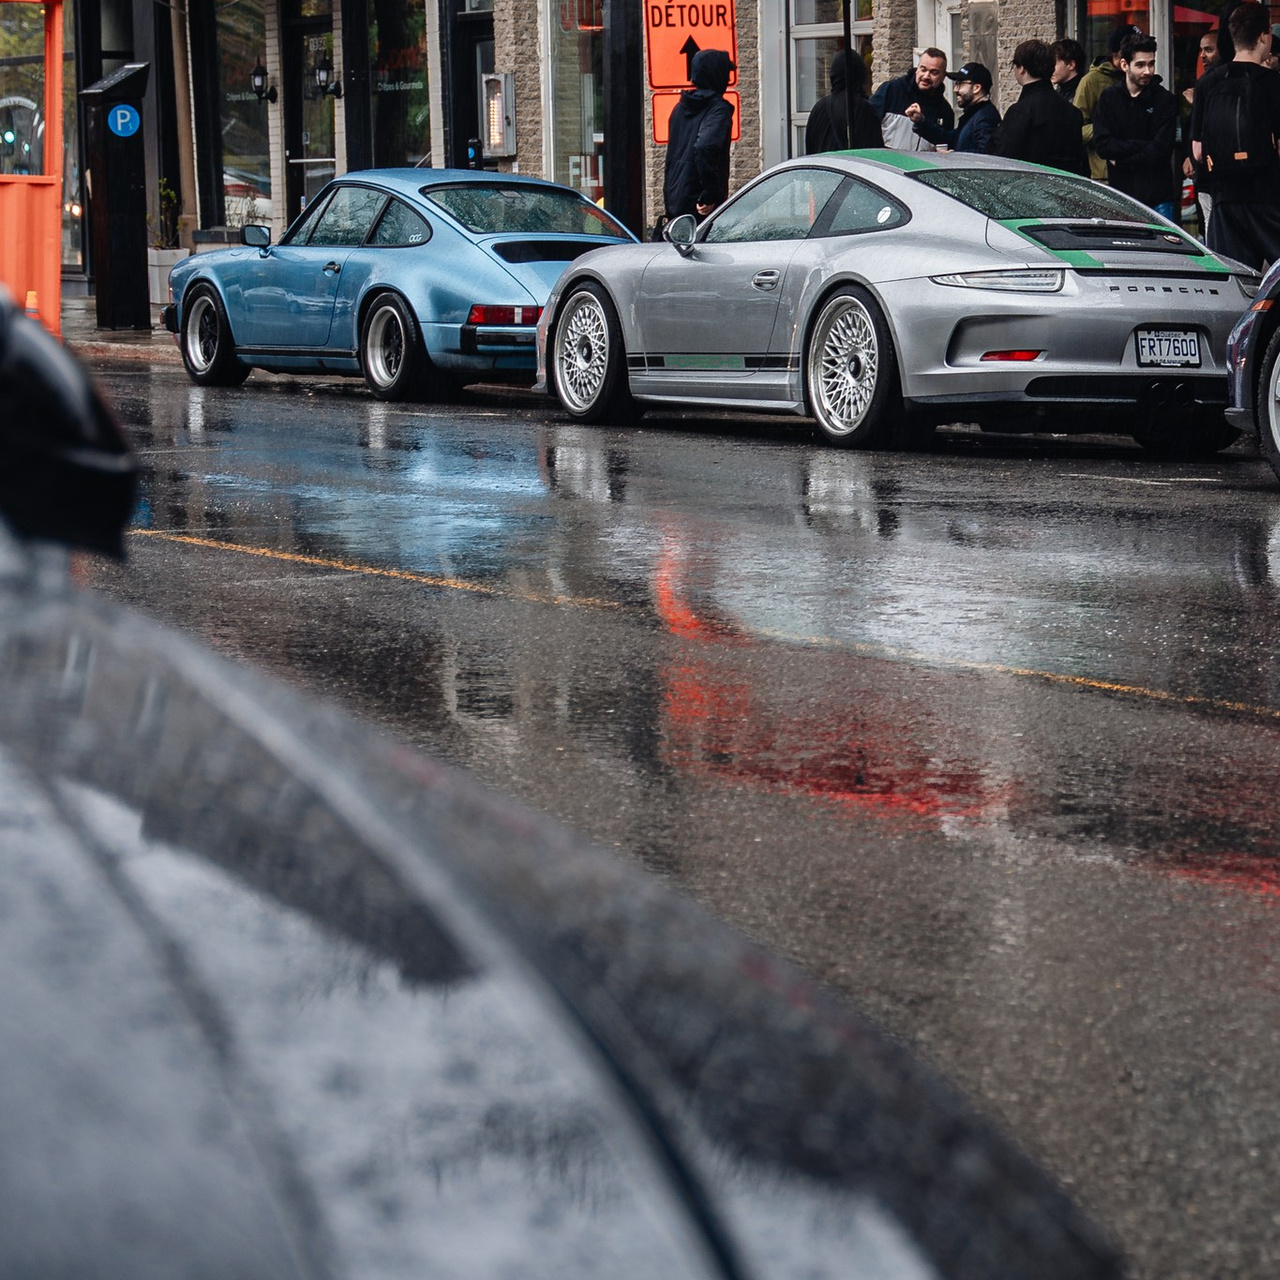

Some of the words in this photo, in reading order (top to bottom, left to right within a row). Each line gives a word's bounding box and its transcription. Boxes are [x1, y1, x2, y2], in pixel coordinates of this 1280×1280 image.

[651, 0, 728, 28] DÉTOUR
[1109, 285, 1219, 295] PORSCHE
[1140, 337, 1197, 357] FRT7600
